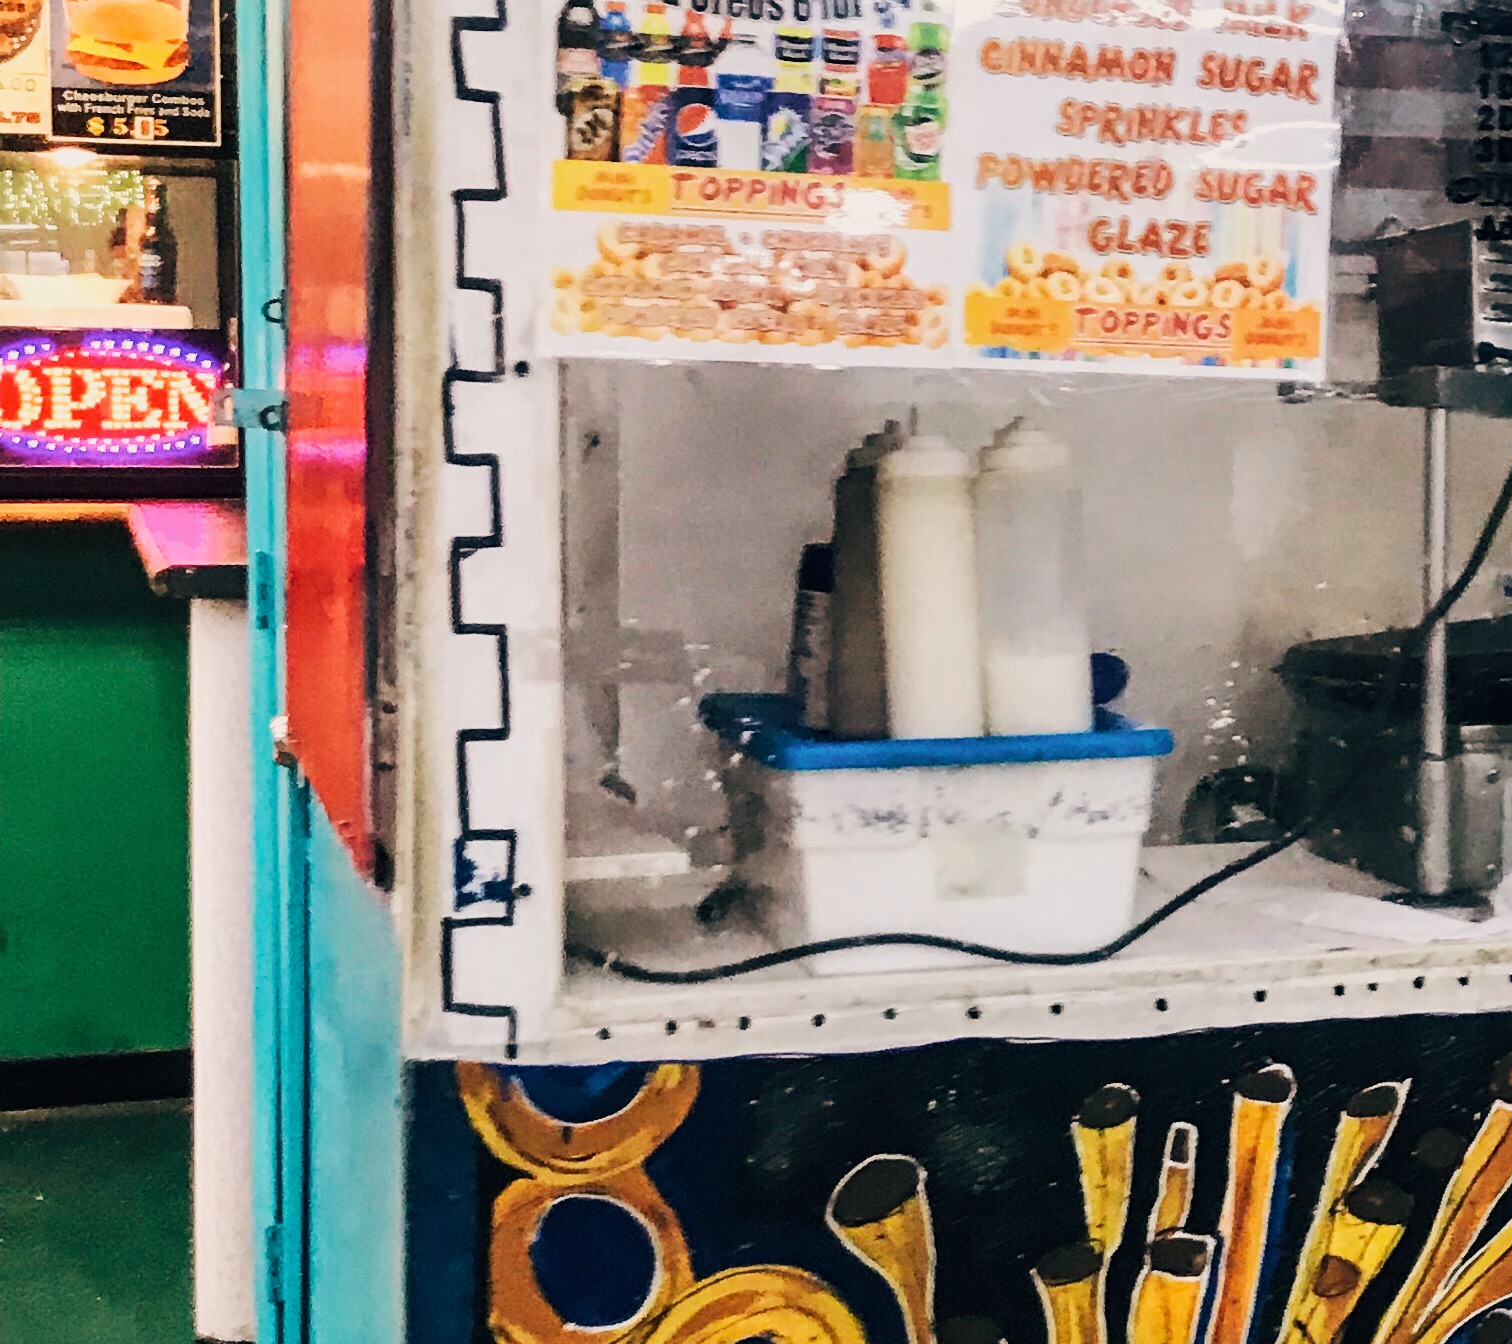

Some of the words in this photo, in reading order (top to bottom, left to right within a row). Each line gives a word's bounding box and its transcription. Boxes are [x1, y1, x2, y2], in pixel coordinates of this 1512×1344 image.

[979, 38, 1176, 86] CINNAMON
[1196, 50, 1321, 103] SUGAR
[1055, 97, 1249, 147] SPRINKLES
[670, 173, 845, 210] TOPPINGS
[974, 152, 1174, 203] POWDERED
[1194, 167, 1320, 215] SUGAR
[1087, 216, 1213, 258] GLAZE
[1075, 307, 1232, 340] TOPPINGS
[0, 368, 217, 429] OPEN
